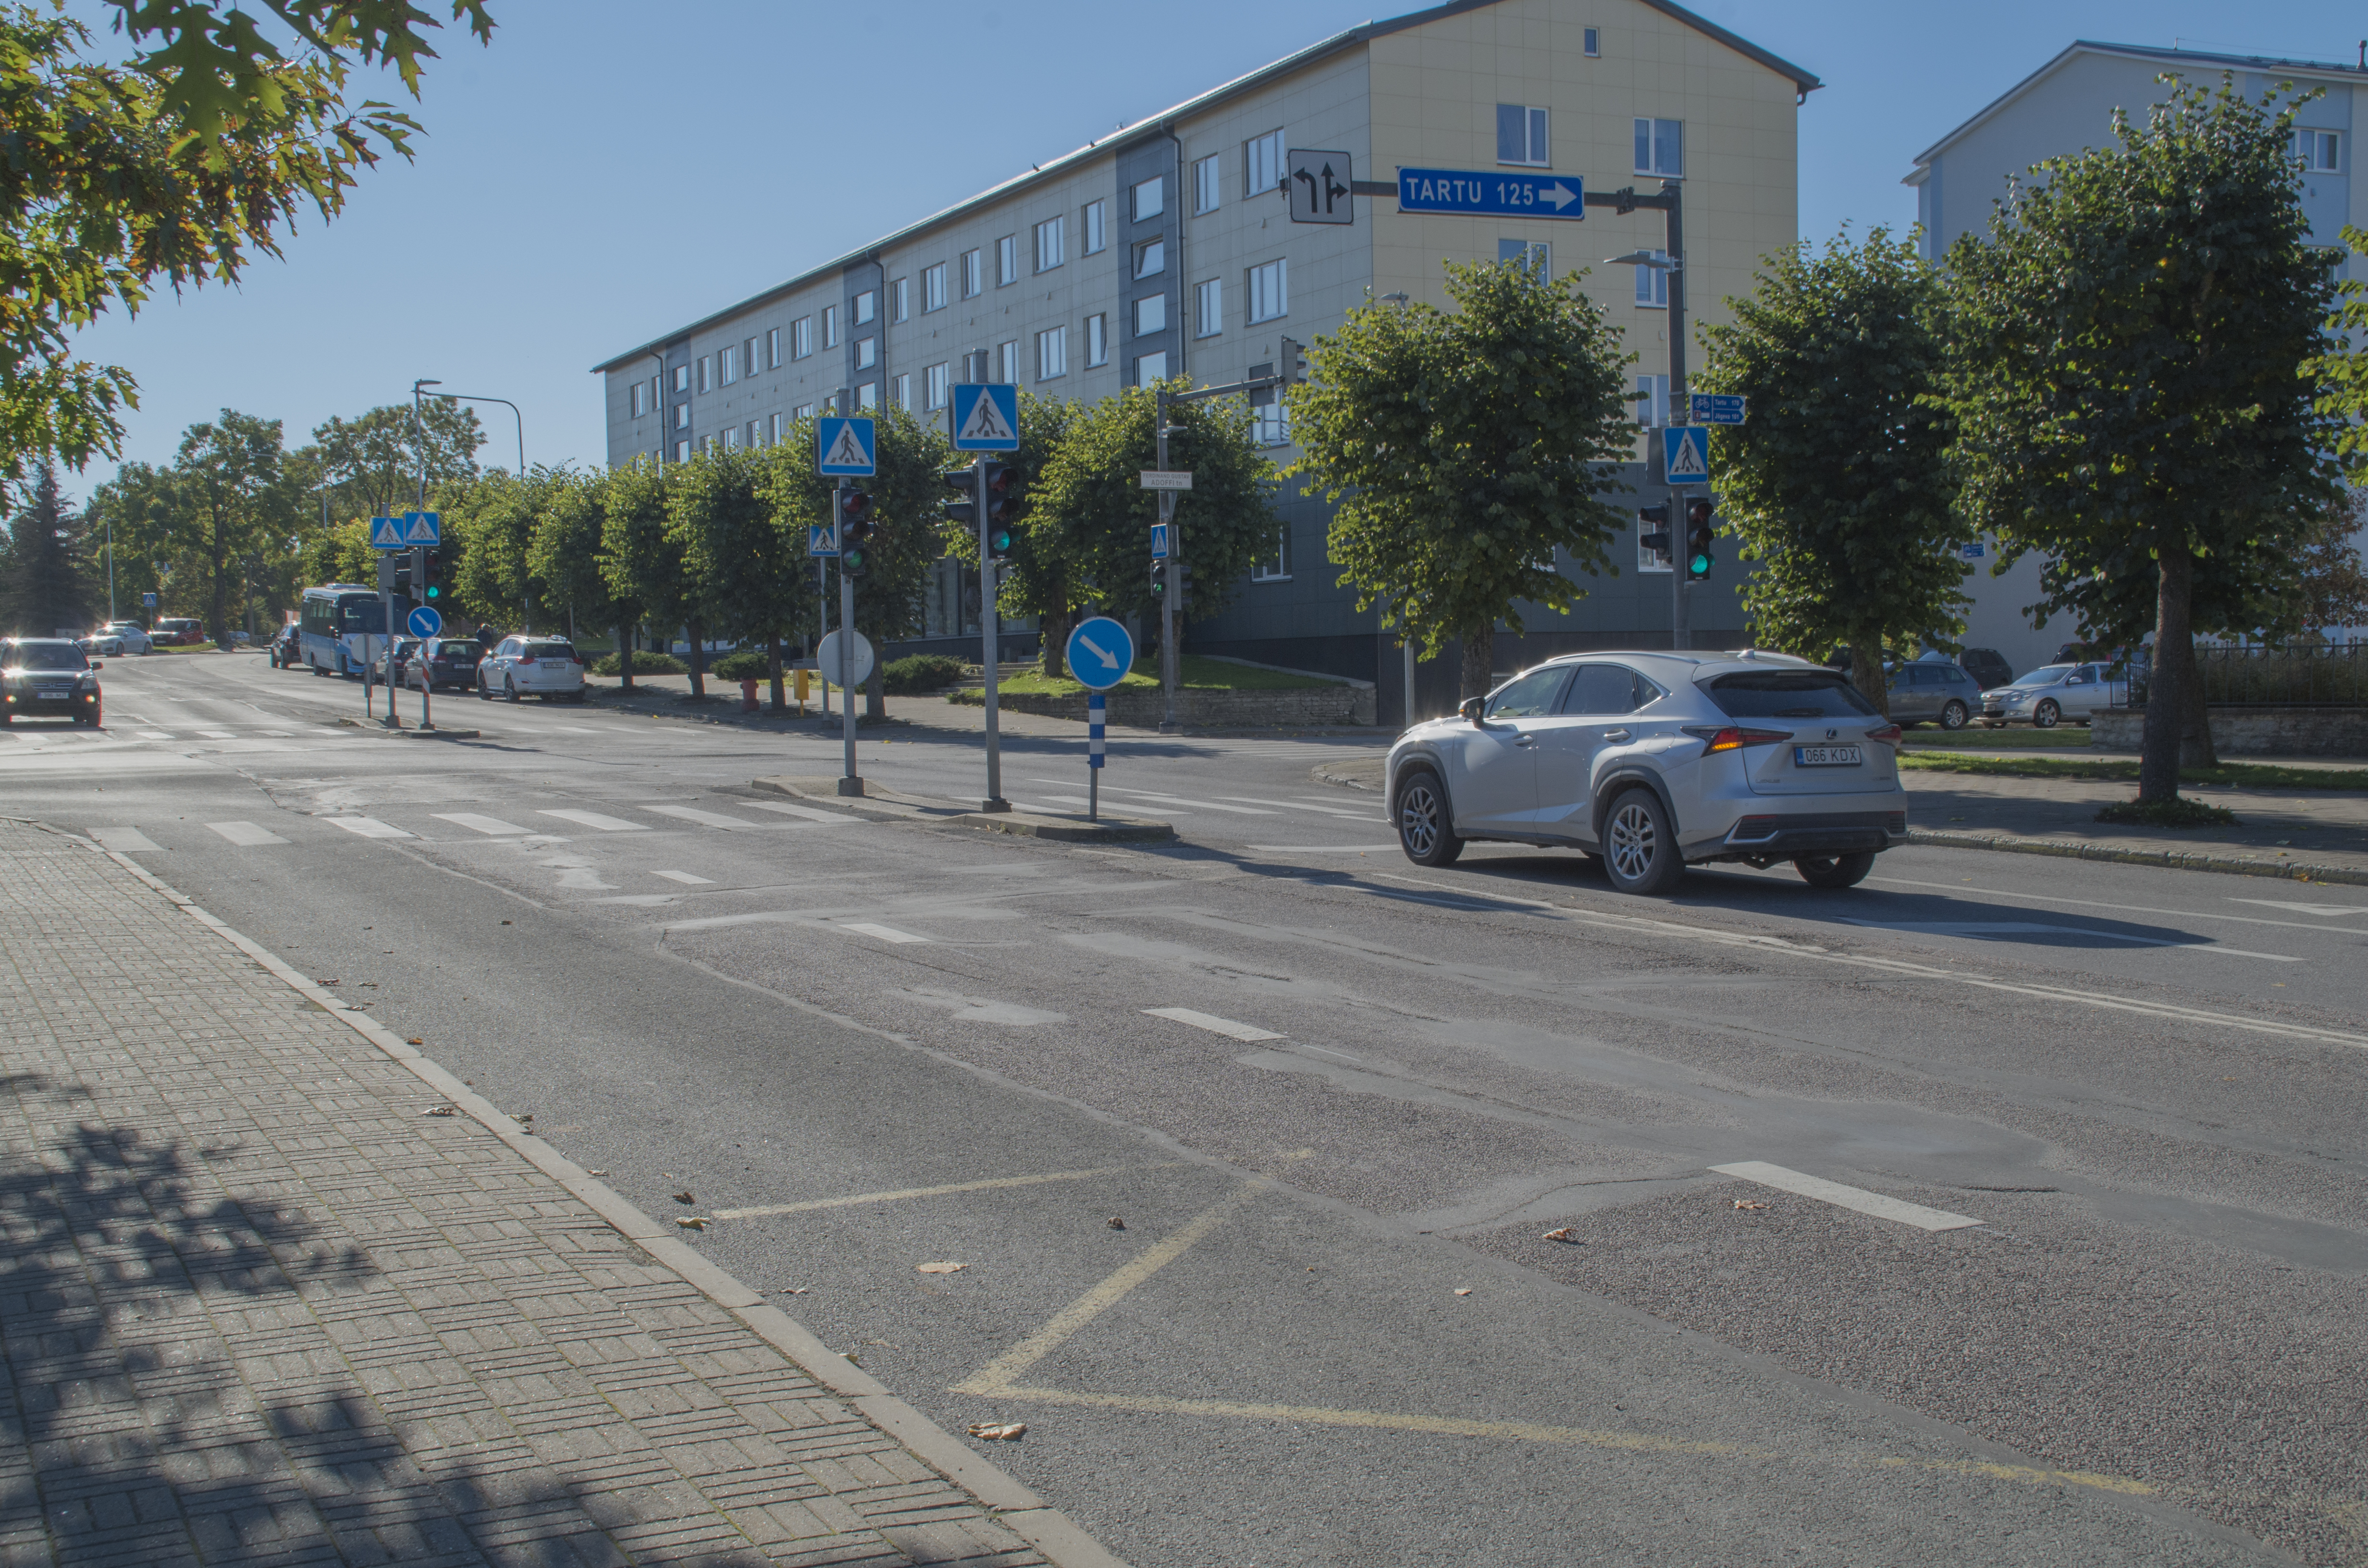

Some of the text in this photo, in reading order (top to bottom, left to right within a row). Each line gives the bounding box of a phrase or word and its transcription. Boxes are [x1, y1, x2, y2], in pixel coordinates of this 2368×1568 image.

[1406, 177, 1533, 206] TARTU 125
[1806, 748, 1857, 761] 066 KDX
